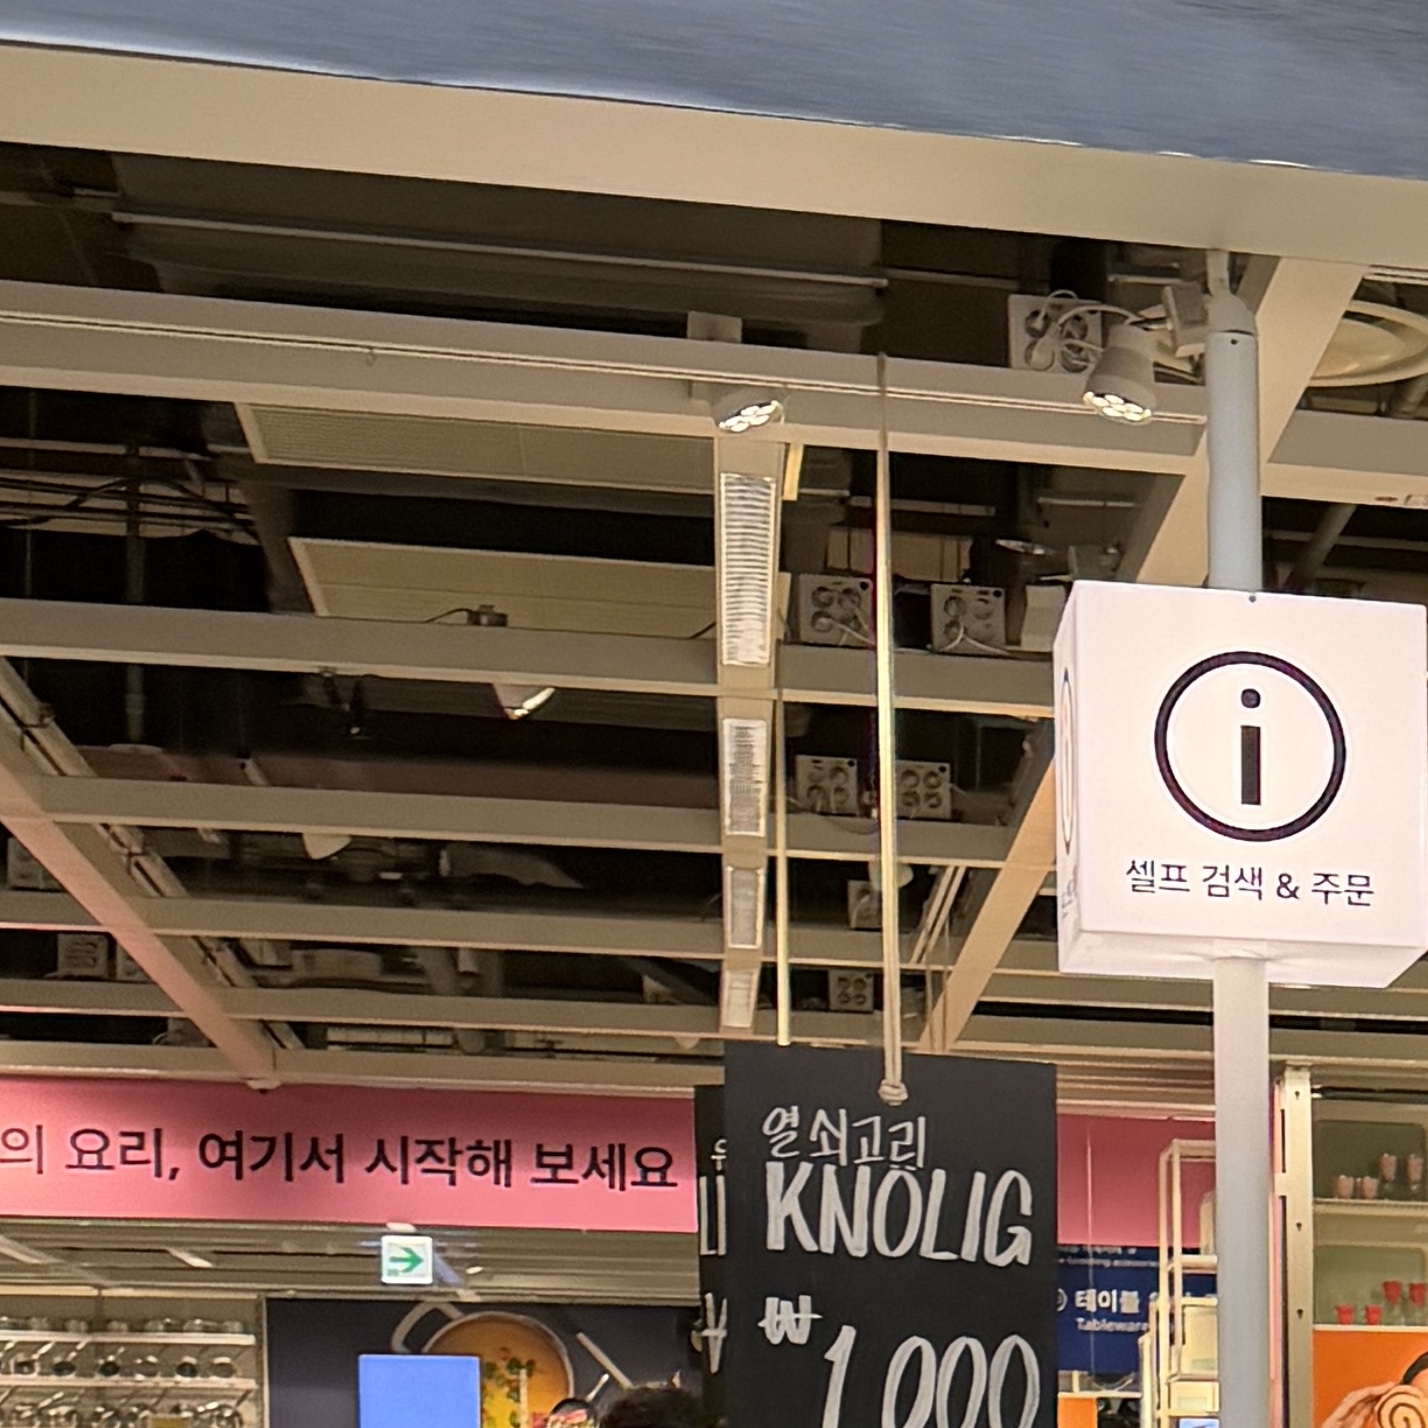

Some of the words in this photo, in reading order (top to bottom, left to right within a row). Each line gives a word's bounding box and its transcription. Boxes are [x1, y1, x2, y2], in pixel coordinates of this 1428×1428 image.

[1126, 860, 1190, 893] 셀프
[1203, 865, 1262, 901] 검색
[1276, 873, 1299, 899] &
[1311, 873, 1374, 906] 주문
[66, 1128, 180, 1180] 요리,
[200, 1128, 345, 1183] 여기서
[364, 1136, 513, 1188] 시작해
[531, 1143, 678, 1191] 보세요
[762, 1105, 925, 1168] 열쇠고리
